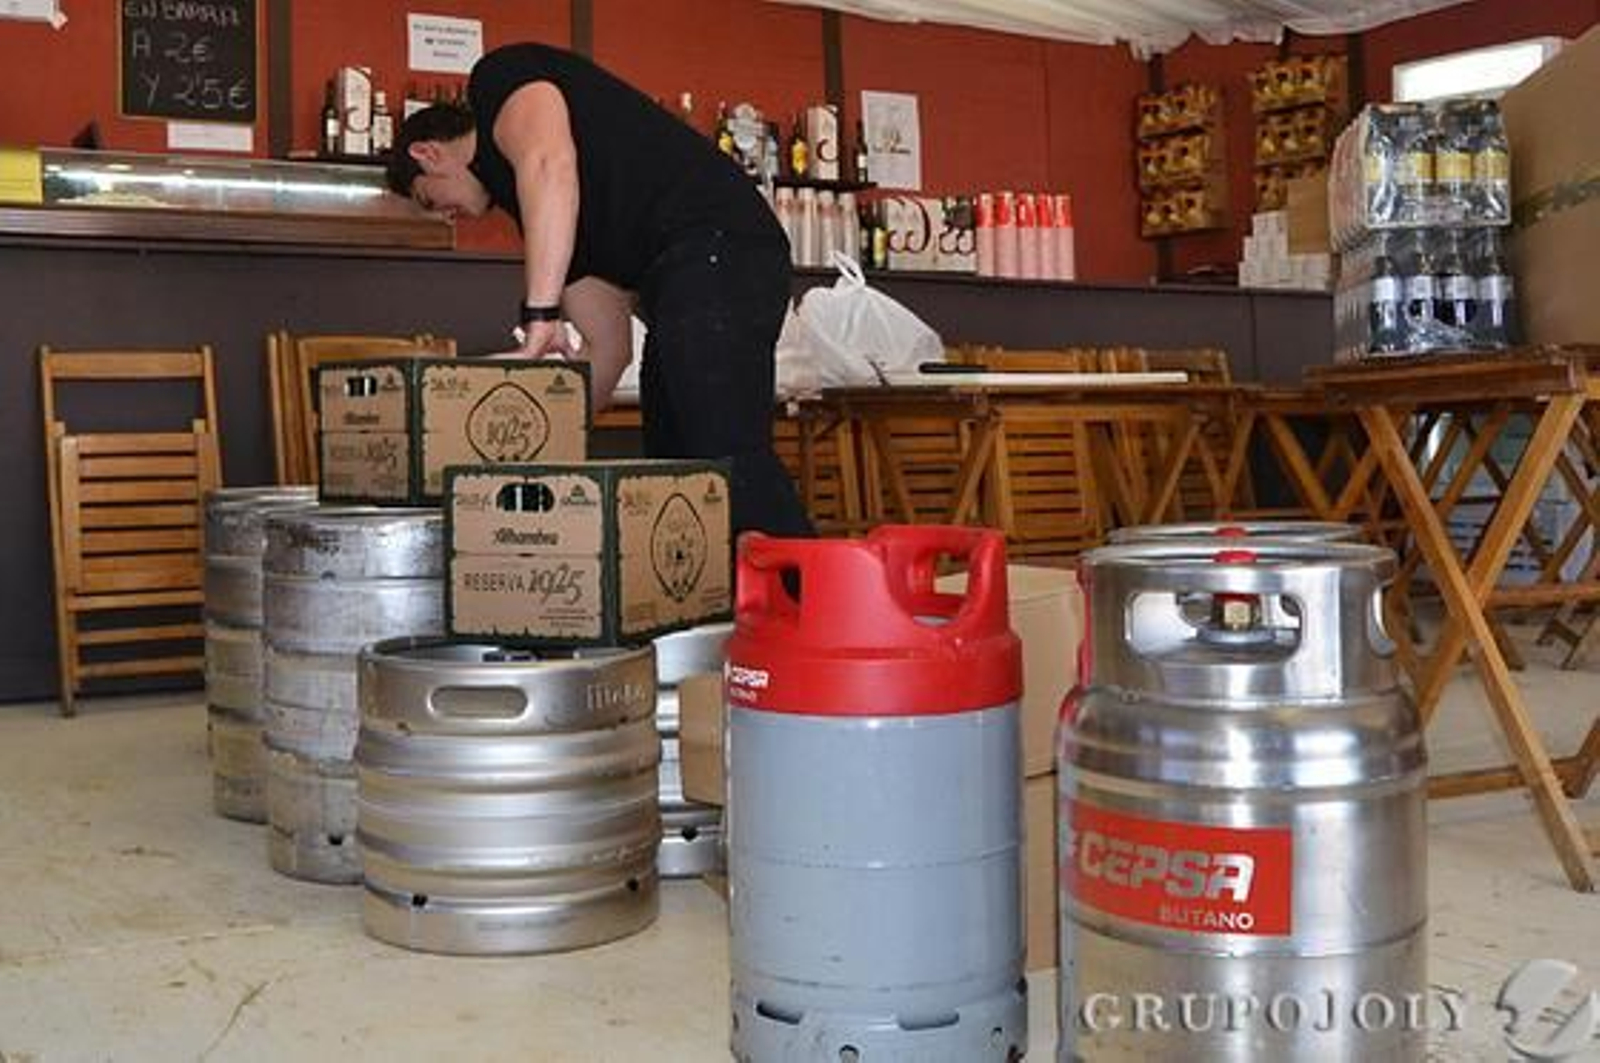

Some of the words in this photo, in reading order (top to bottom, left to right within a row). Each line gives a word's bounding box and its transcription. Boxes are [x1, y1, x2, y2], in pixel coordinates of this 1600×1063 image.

[464, 572, 526, 594] RESERVA
[528, 562, 585, 605] 1925
[1079, 829, 1254, 903] CEPSA
[1158, 902, 1254, 930] BUTANO
